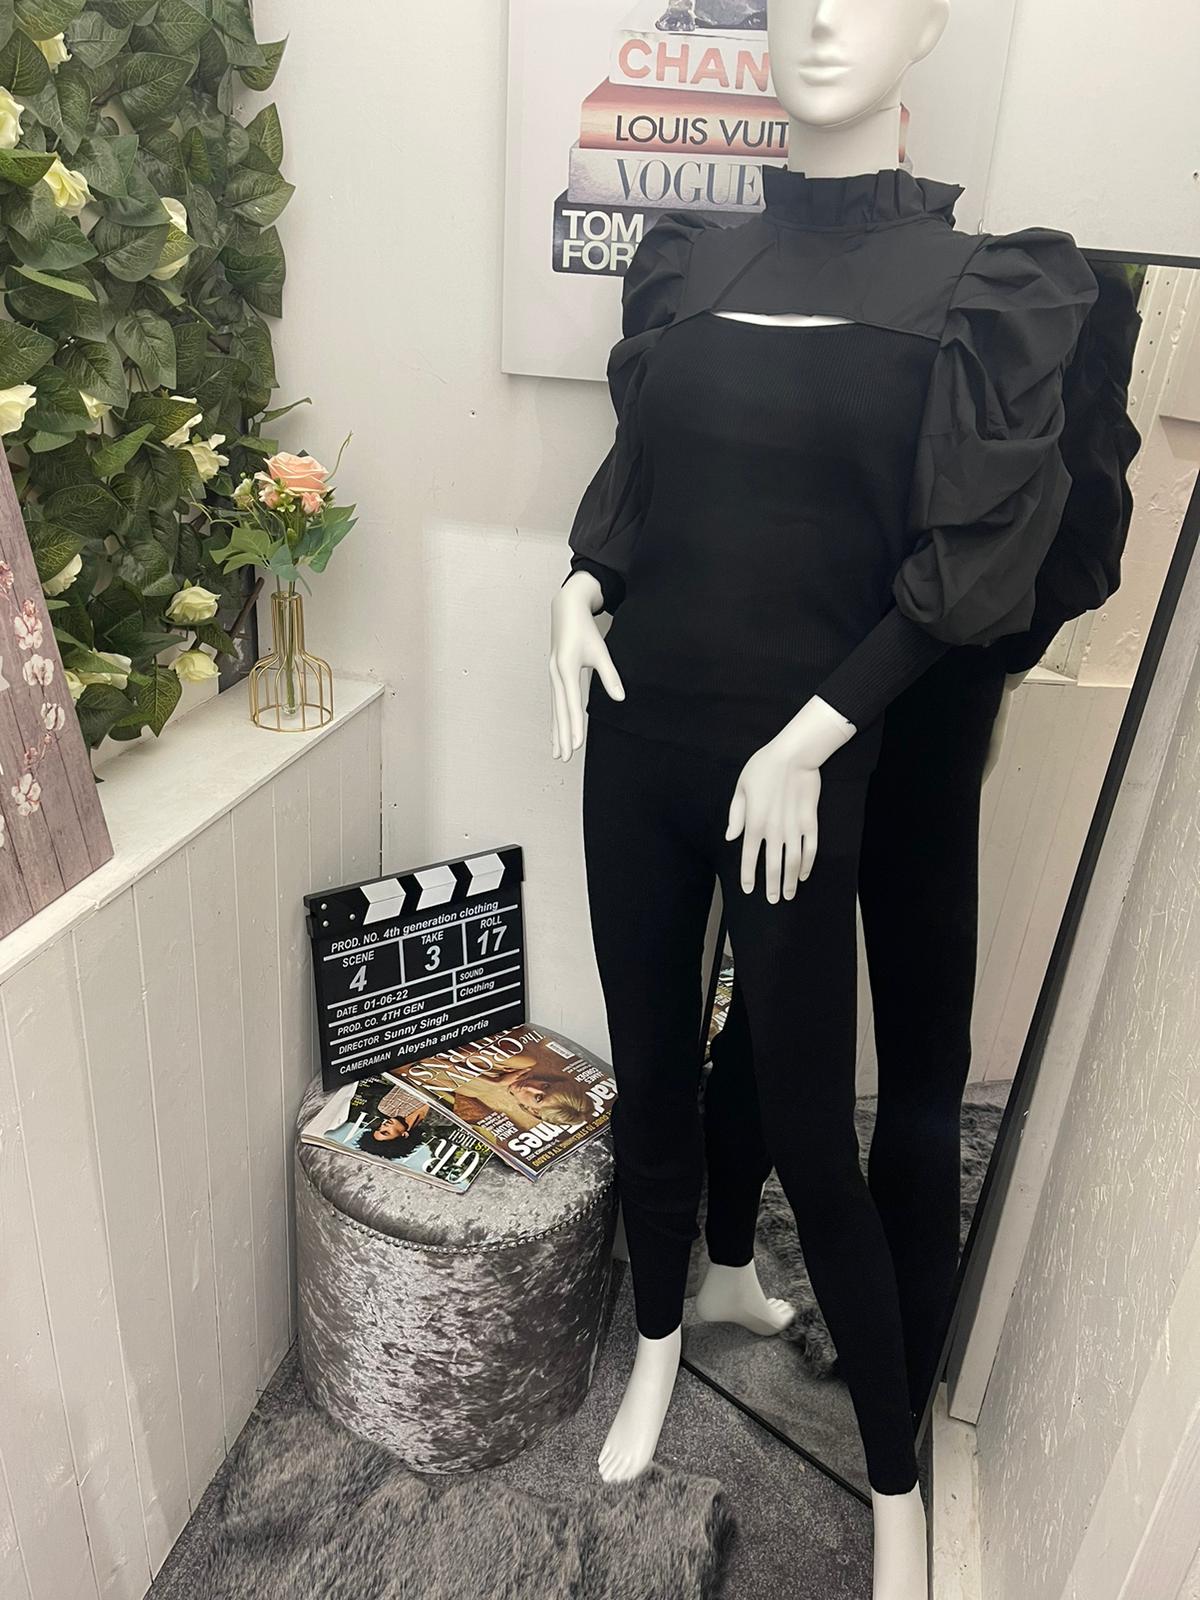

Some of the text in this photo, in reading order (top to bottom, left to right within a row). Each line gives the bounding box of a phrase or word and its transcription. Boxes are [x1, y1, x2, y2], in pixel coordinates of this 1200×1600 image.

[619, 39, 768, 89] CHAN
[616, 115, 789, 148] LOUIS VUIT
[614, 159, 762, 205] VOGUE
[562, 210, 644, 242] TOM
[562, 240, 639, 270] FOR
[331, 902, 498, 952] PROD. NO. 4th generation clothing
[480, 916, 502, 929] ROLL
[421, 931, 444, 945] TAKE
[477, 925, 507, 955] 17
[342, 950, 374, 968] SCENE
[425, 945, 440, 971] 3
[349, 965, 367, 992] 4
[460, 968, 484, 980] SOUND
[460, 981, 494, 996] Clothing
[337, 989, 408, 1018] DATE 01-06-22
[338, 1001, 425, 1035] PROD. CO. 4TH GEN
[339, 1013, 449, 1054] DIRECTOR Sunny Singh
[340, 1020, 488, 1074] CAMERAMAN Aleysha and Portia
[421, 1030, 546, 1099] The CROWN
